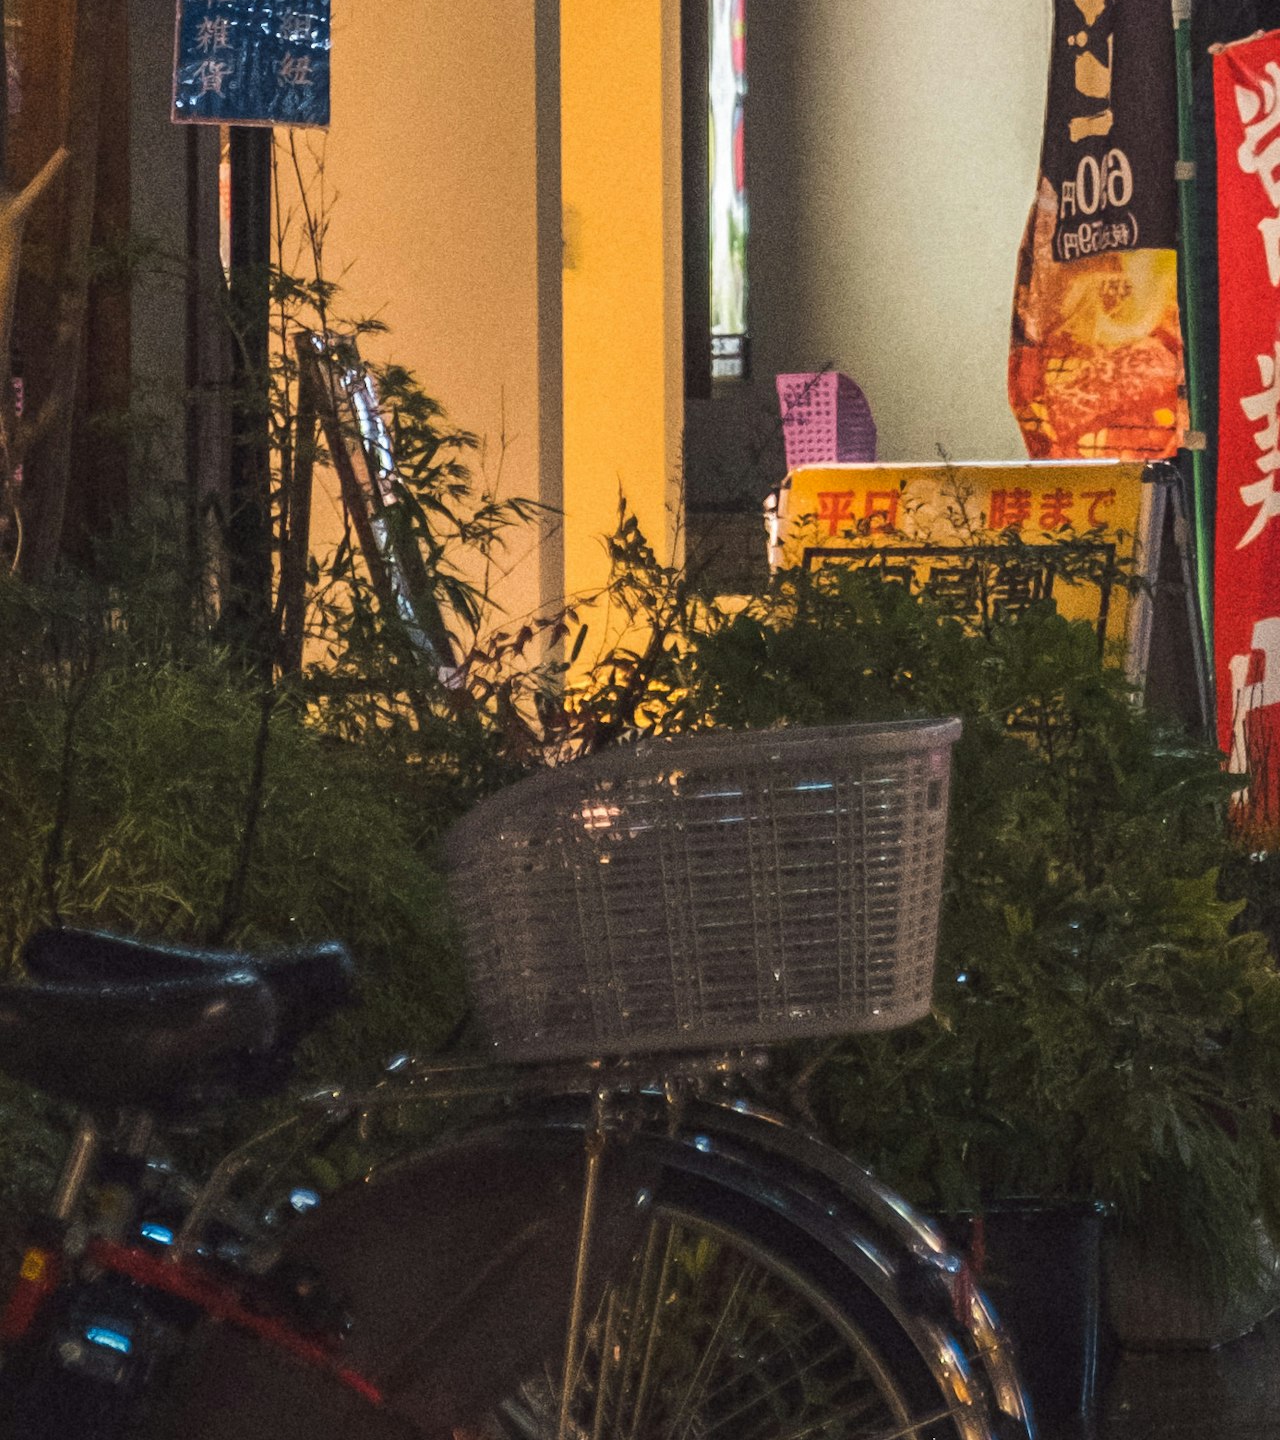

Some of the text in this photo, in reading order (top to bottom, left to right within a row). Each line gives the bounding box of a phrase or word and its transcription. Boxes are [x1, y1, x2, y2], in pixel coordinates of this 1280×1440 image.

[817, 486, 1117, 536] 平日 時まで
